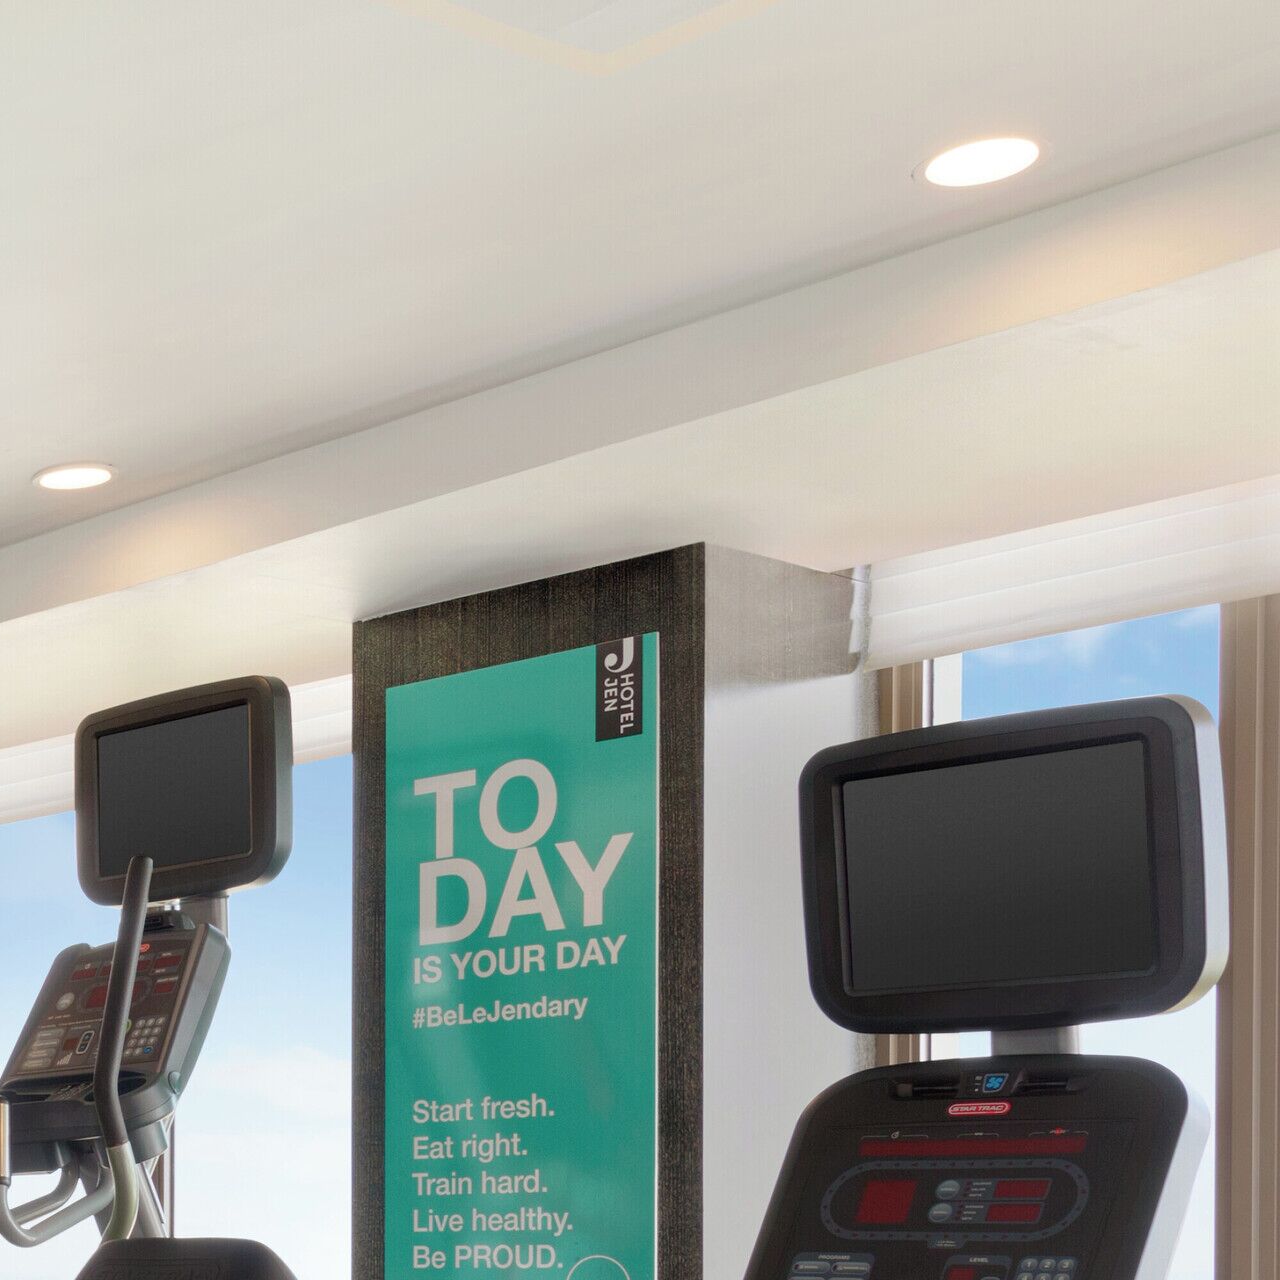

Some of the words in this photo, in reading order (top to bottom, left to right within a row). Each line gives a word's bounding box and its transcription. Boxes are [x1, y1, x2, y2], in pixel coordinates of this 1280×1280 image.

[604, 677, 618, 712] JEN
[620, 672, 634, 734] HOTEL
[413, 758, 558, 860] TO
[419, 832, 634, 946] DAY
[414, 956, 442, 985] IS
[450, 943, 546, 980] YOUR
[556, 934, 628, 970] DAY
[412, 996, 588, 1029] #BeLeJendary
[412, 1098, 473, 1124] Start
[481, 1093, 555, 1120] fresh.
[412, 1135, 454, 1160] Eat
[461, 1132, 528, 1163] right.
[412, 1171, 473, 1196] Train
[481, 1168, 548, 1195] hard.
[412, 1208, 464, 1233] Live
[471, 1206, 573, 1237] healthy.
[412, 1245, 446, 1270] Be
[454, 1244, 564, 1270] PROUD.
